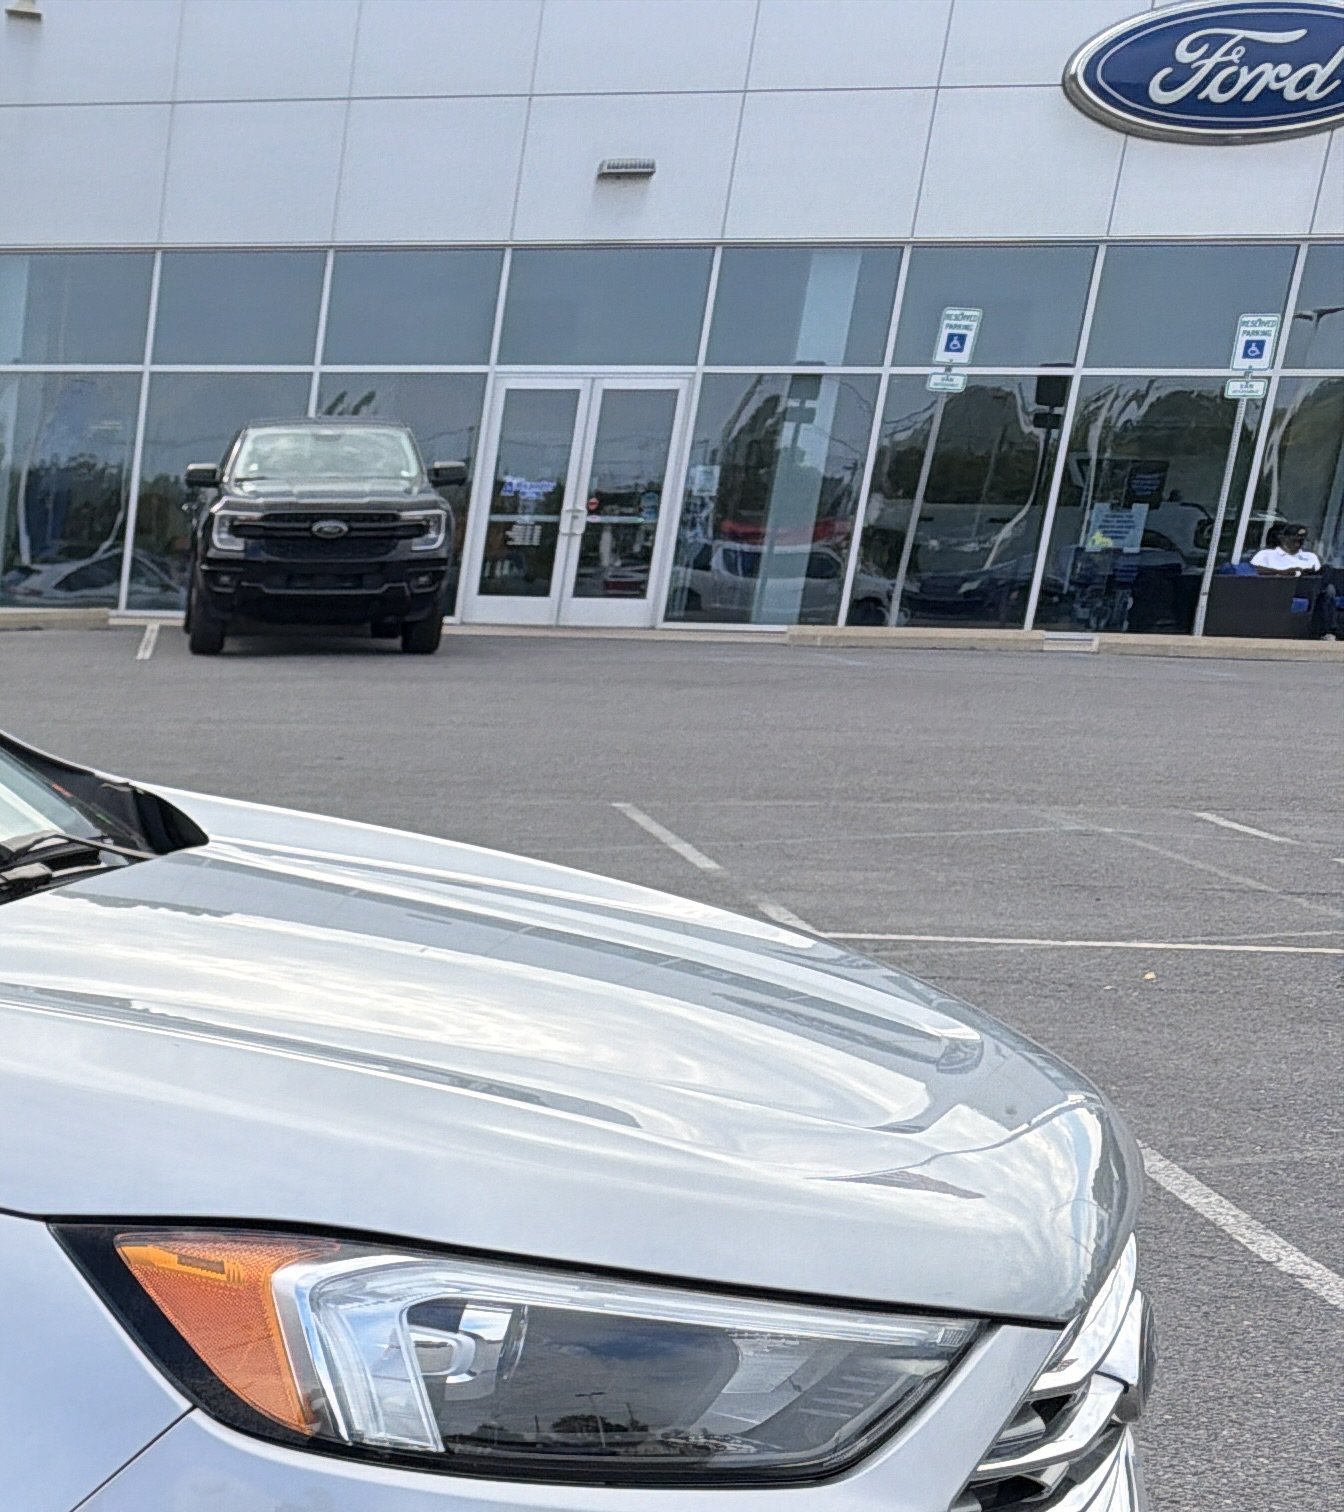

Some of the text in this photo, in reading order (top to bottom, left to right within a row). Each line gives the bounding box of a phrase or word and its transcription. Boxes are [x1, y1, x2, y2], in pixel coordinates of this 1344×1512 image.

[1148, 28, 1344, 105] Ford
[1240, 319, 1277, 328] RESERVED
[1241, 329, 1273, 337] PARKING
